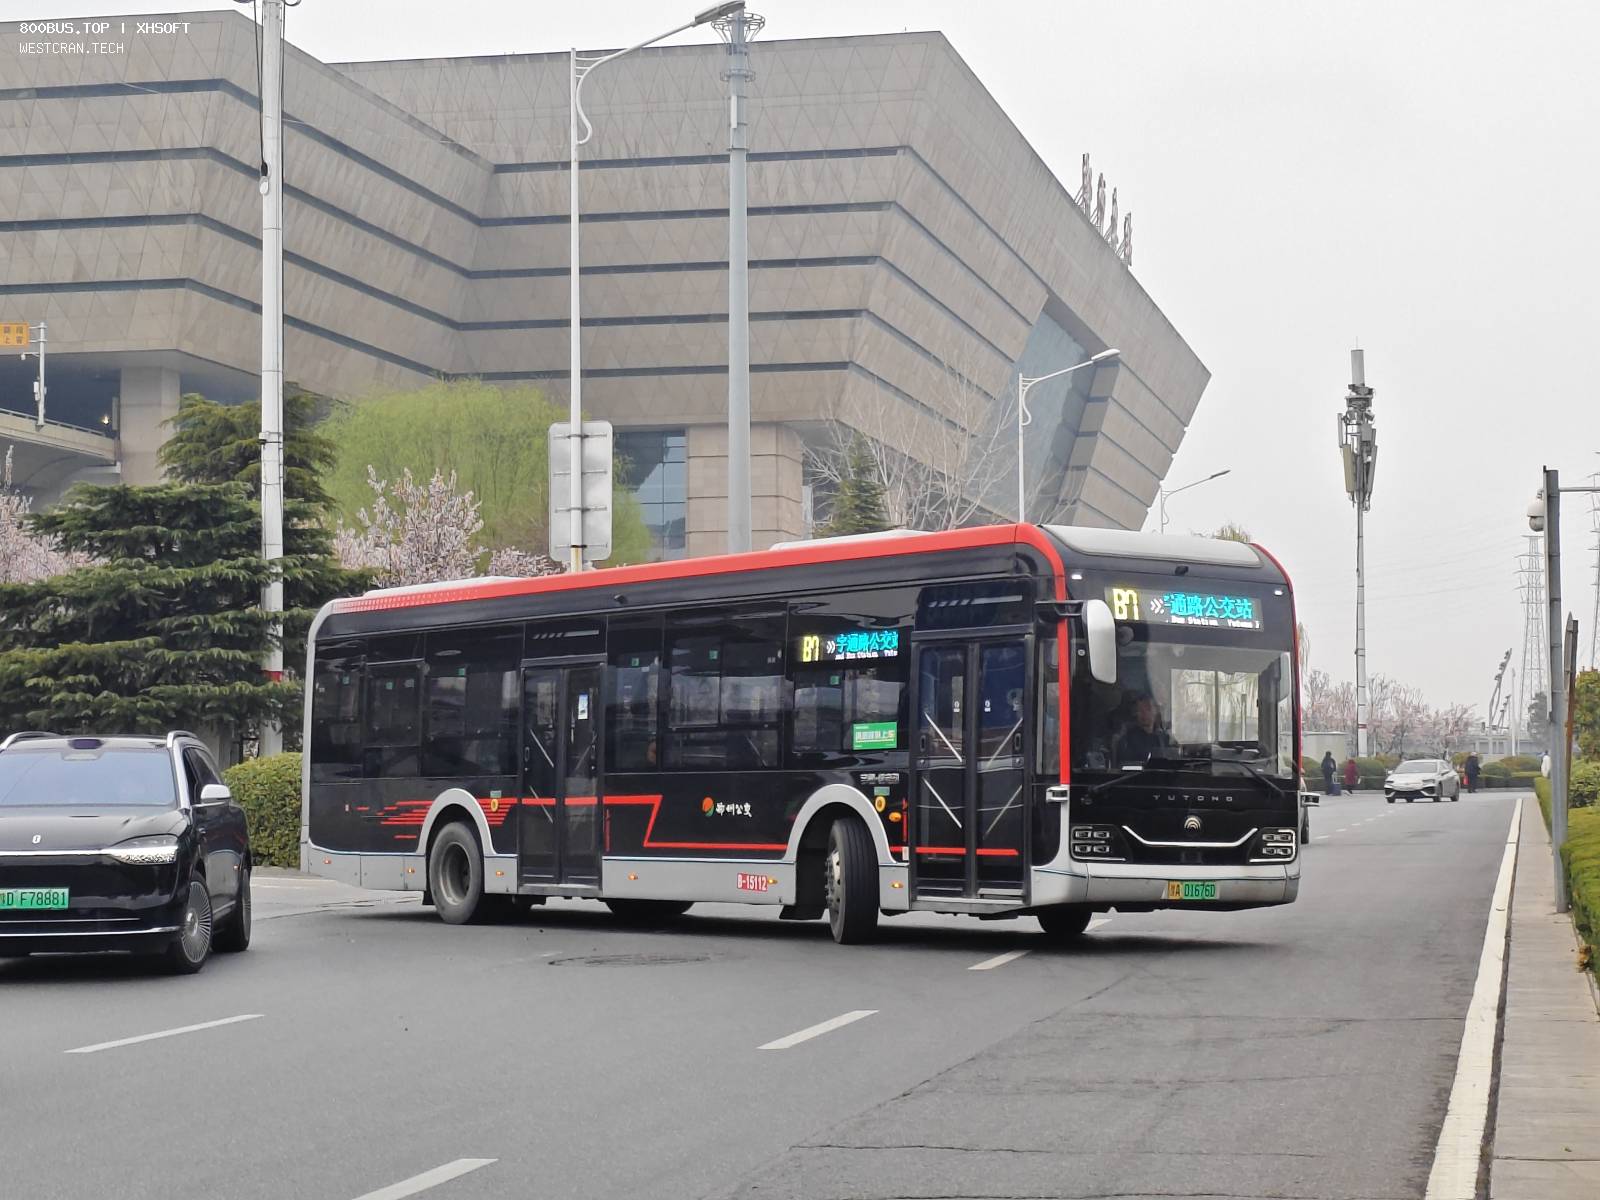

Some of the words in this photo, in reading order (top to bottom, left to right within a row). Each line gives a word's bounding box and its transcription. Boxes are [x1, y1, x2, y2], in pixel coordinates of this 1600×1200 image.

[1113, 588, 1139, 620] B7
[803, 635, 819, 662] B7
[738, 874, 767, 891] B-15112
[21, 891, 66, 906] F78881
